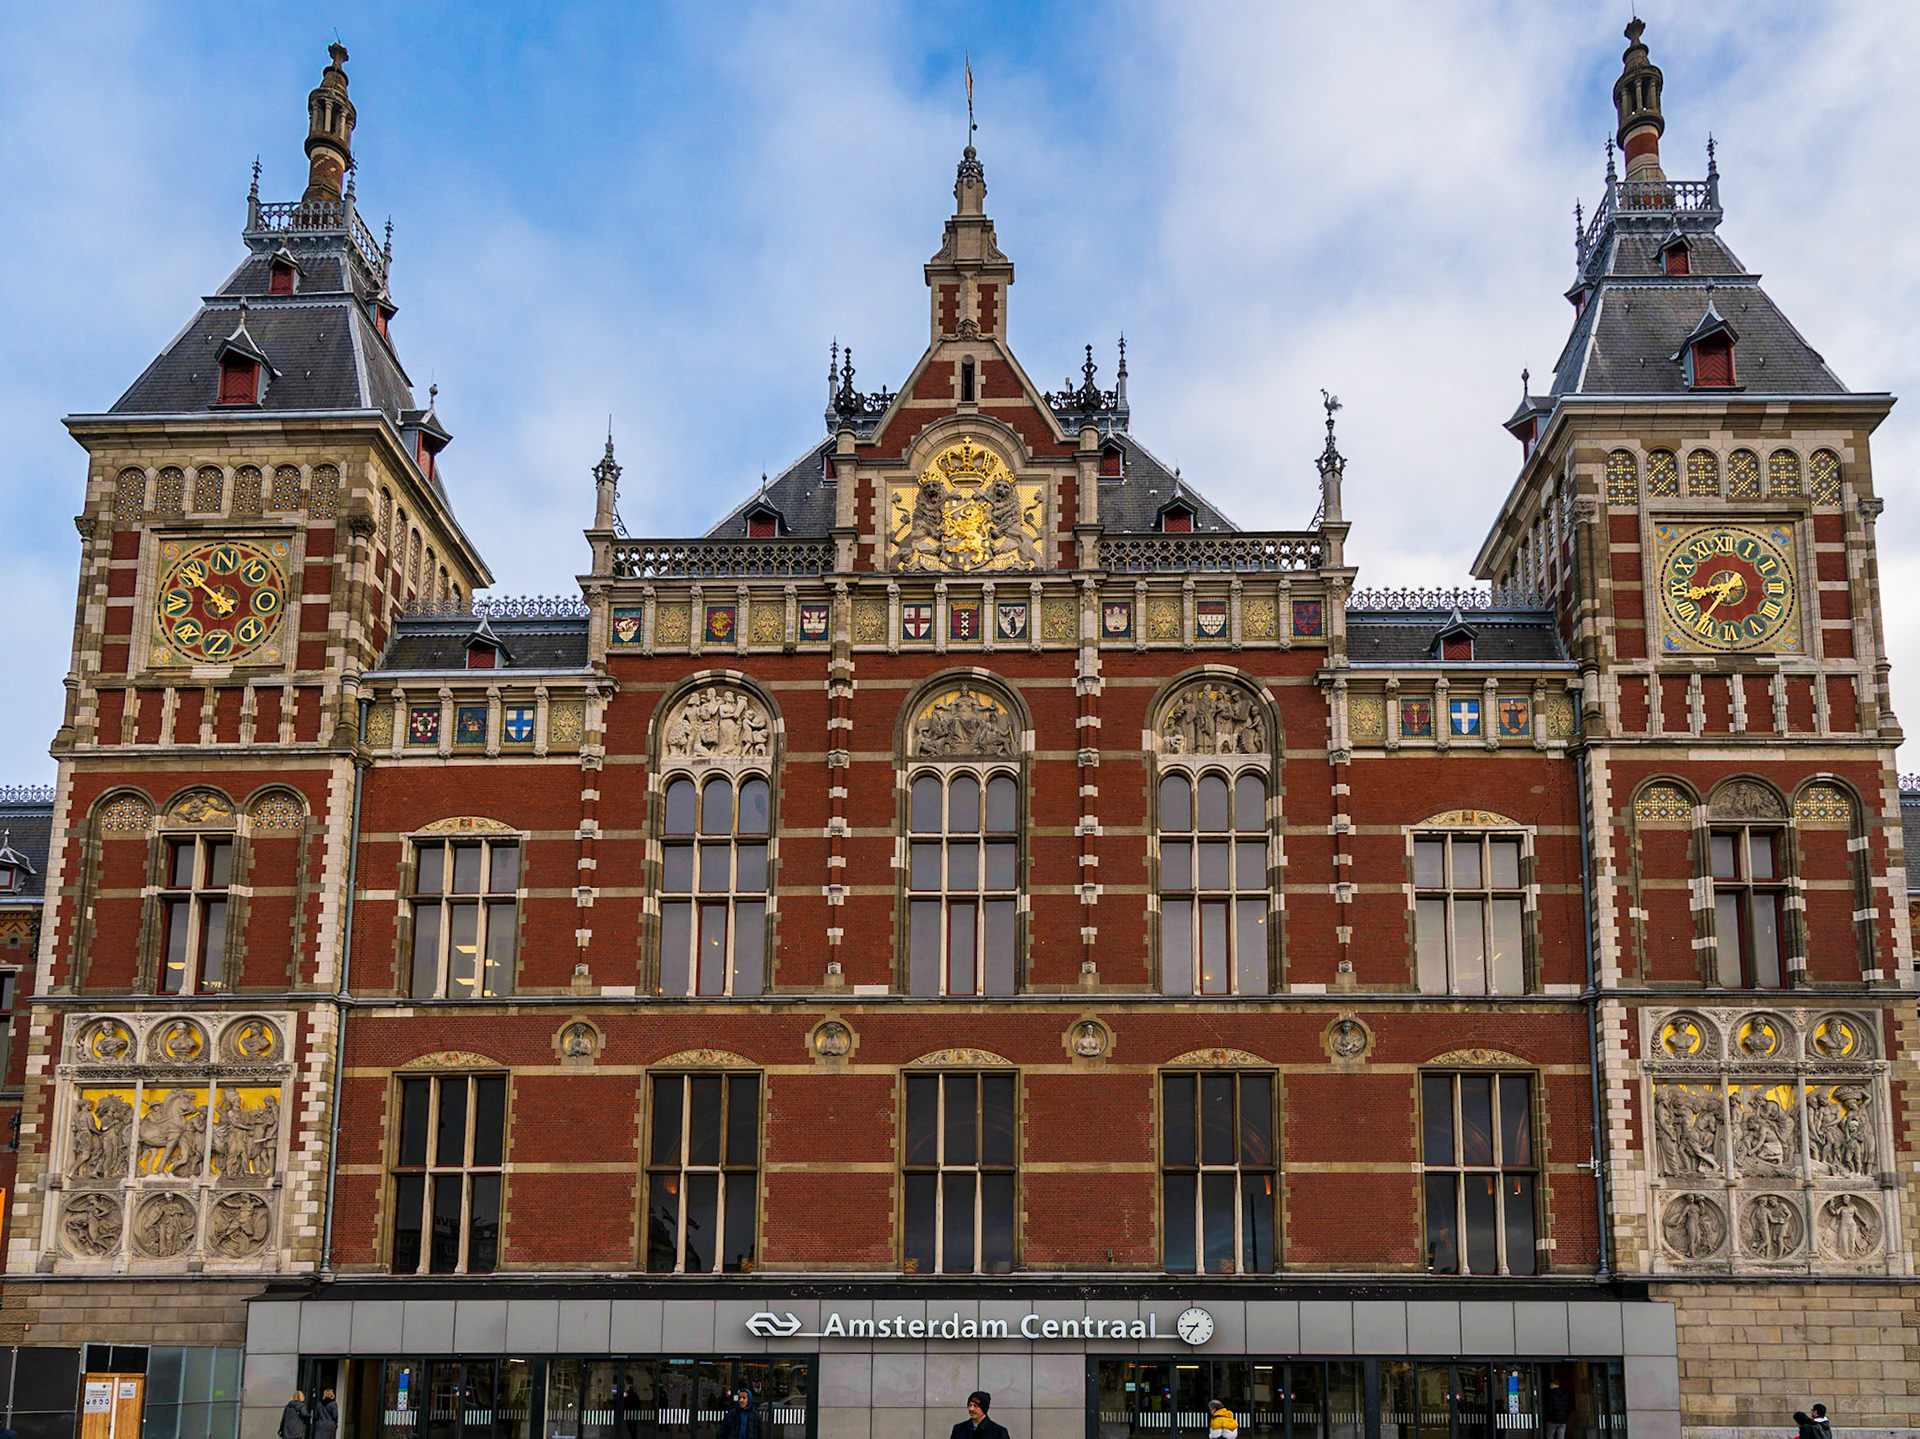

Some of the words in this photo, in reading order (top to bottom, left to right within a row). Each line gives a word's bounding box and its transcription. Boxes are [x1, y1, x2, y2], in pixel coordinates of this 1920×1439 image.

[1690, 540, 1711, 558] XI
[1713, 537, 1734, 552] XII
[1743, 542, 1755, 558] I
[216, 551, 235, 570] N
[1675, 558, 1694, 574] X
[1759, 558, 1777, 574] II
[1671, 581, 1688, 598] IX
[1768, 581, 1785, 595] III
[167, 594, 188, 614] W
[255, 592, 275, 611] O
[1723, 625, 1739, 641] VI
[1749, 619, 1764, 636] V
[208, 634, 227, 655] Z
[823, 1312, 1008, 1339] Amsterdam
[1020, 1312, 1157, 1339] Centraal
